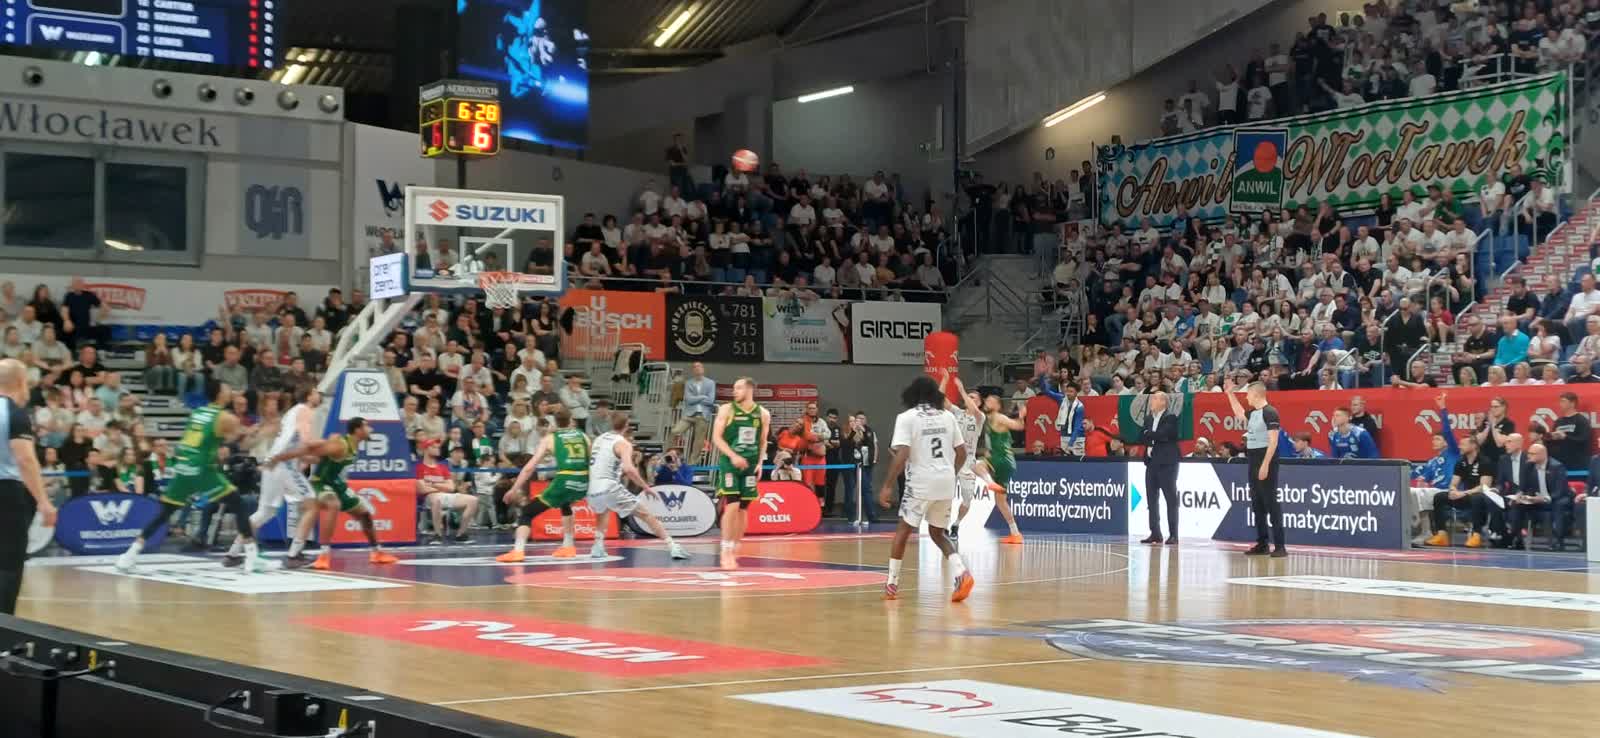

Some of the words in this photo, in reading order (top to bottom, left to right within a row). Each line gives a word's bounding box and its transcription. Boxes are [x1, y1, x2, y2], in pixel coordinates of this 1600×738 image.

[0, 102, 220, 147] Włocławek
[472, 122, 493, 149] 6
[1237, 181, 1278, 195] ANWIL
[455, 204, 545, 223] SUZUKI
[732, 303, 757, 318] 781
[731, 322, 758, 337] 715
[860, 320, 933, 340] GIRDER
[732, 341, 757, 355] 511
[931, 437, 944, 459] 2
[343, 458, 408, 473] ERBUD
[1059, 477, 1125, 500] Systemów
[1231, 481, 1307, 504] Intator
[1311, 483, 1396, 509] Systemów
[760, 514, 791, 523] ORLEN
[1010, 498, 1111, 523] Informatycznych
[476, 631, 706, 663] ORLEN
